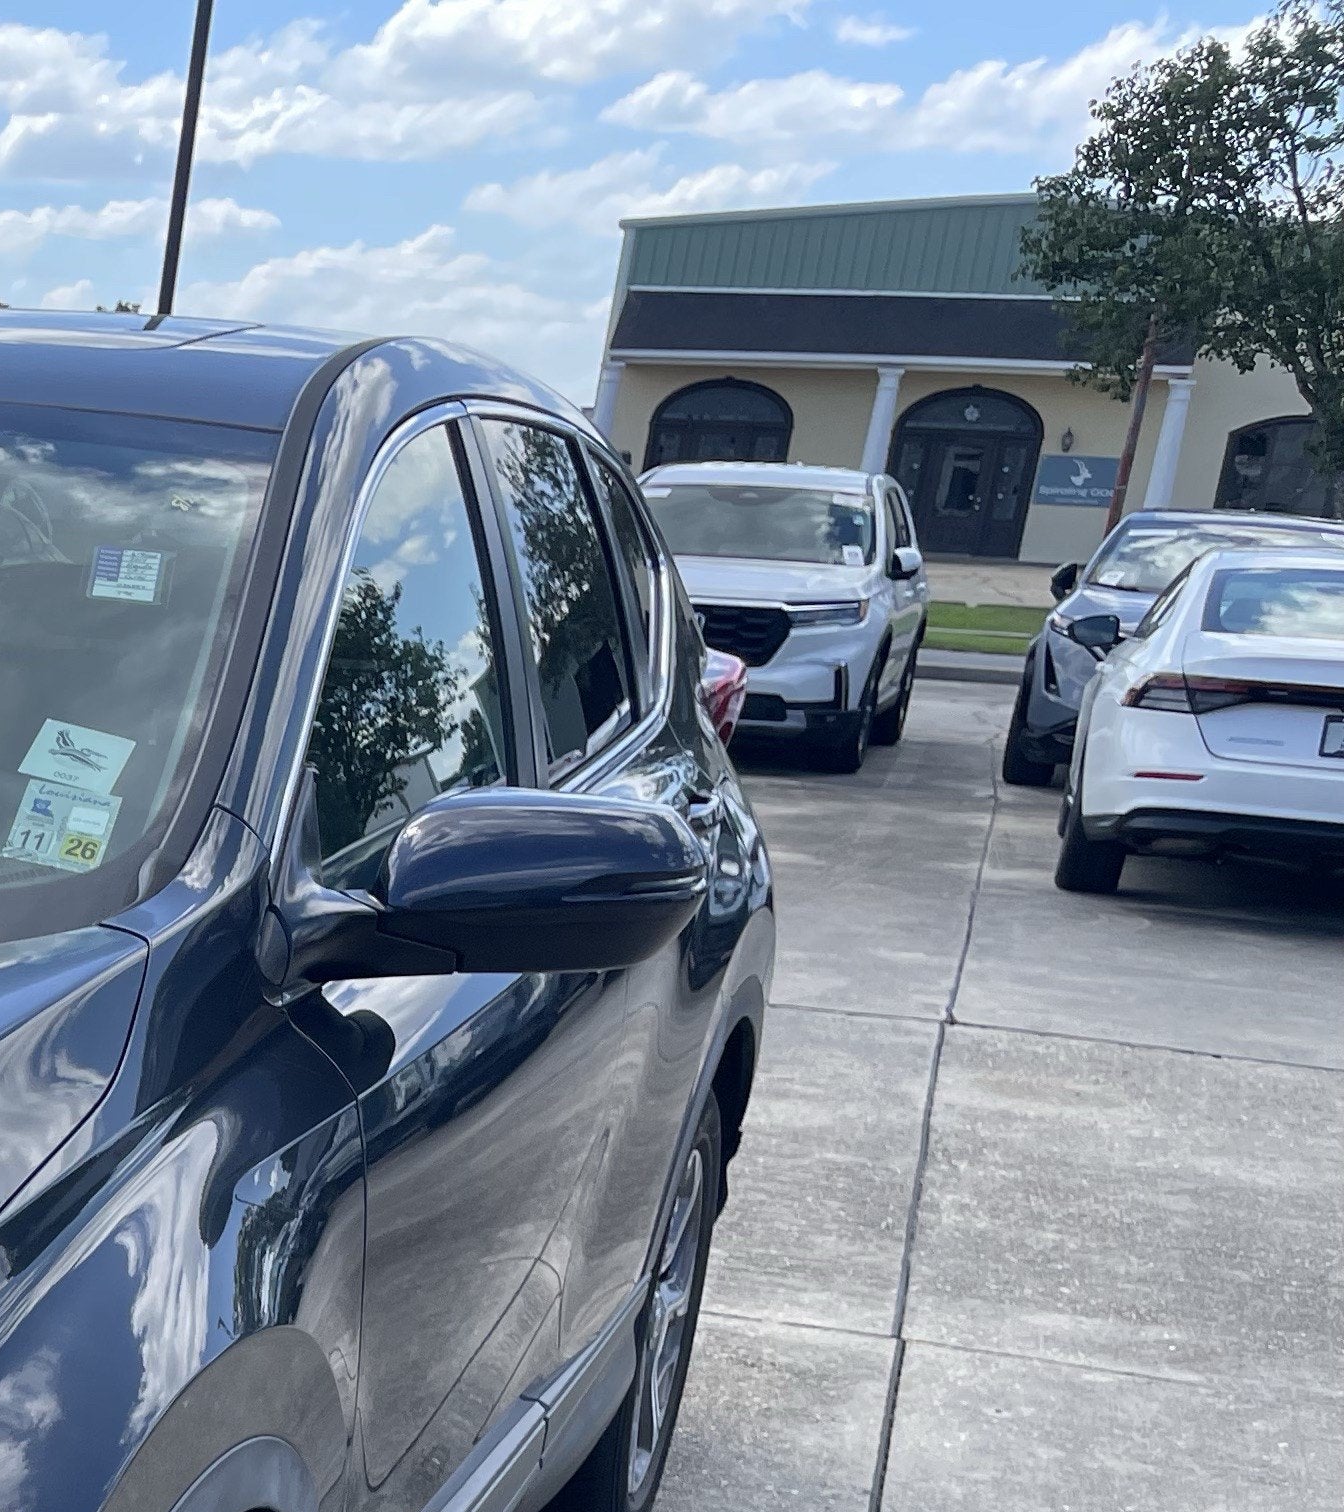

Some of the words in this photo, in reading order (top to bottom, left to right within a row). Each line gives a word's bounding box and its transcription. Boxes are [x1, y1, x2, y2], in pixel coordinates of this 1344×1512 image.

[39, 784, 111, 807] Louisiana
[20, 829, 45, 851] 11
[65, 837, 98, 860] 26
